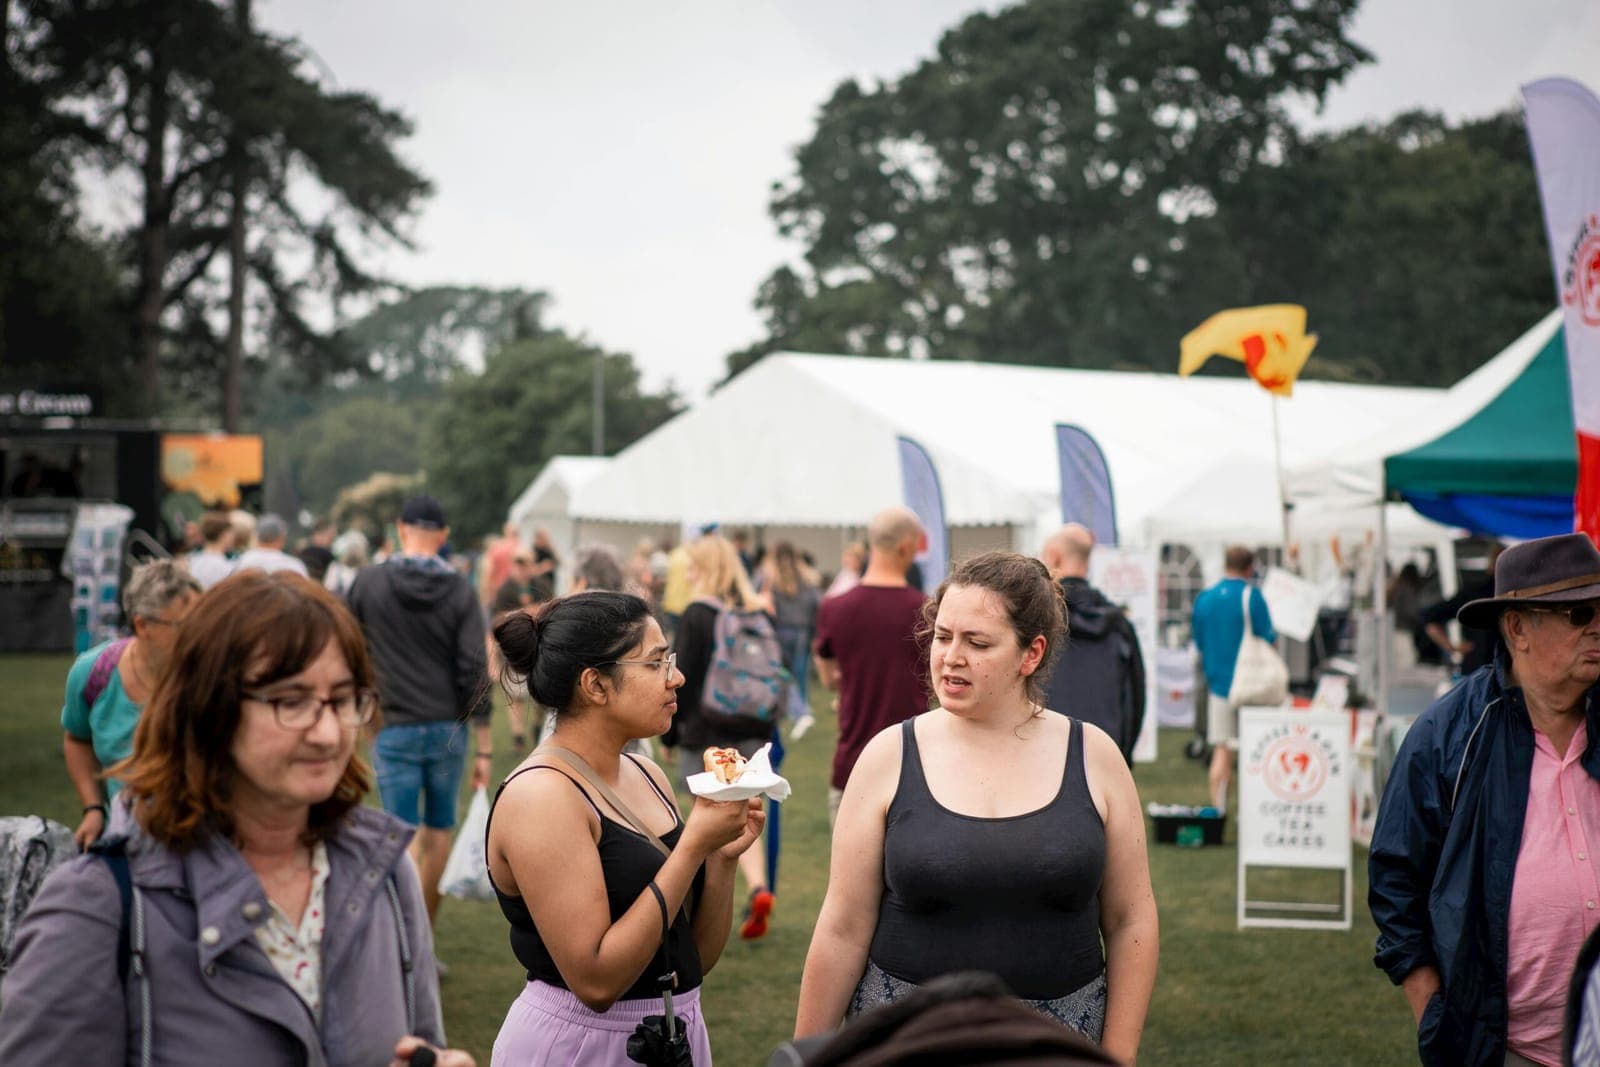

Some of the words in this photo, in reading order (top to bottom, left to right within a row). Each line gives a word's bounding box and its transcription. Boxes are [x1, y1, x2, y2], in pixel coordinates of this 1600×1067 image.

[18, 389, 92, 415] Cream
[1260, 801, 1328, 816] COFFEE
[1279, 817, 1313, 832] TEA
[1262, 832, 1326, 849] CAKES
